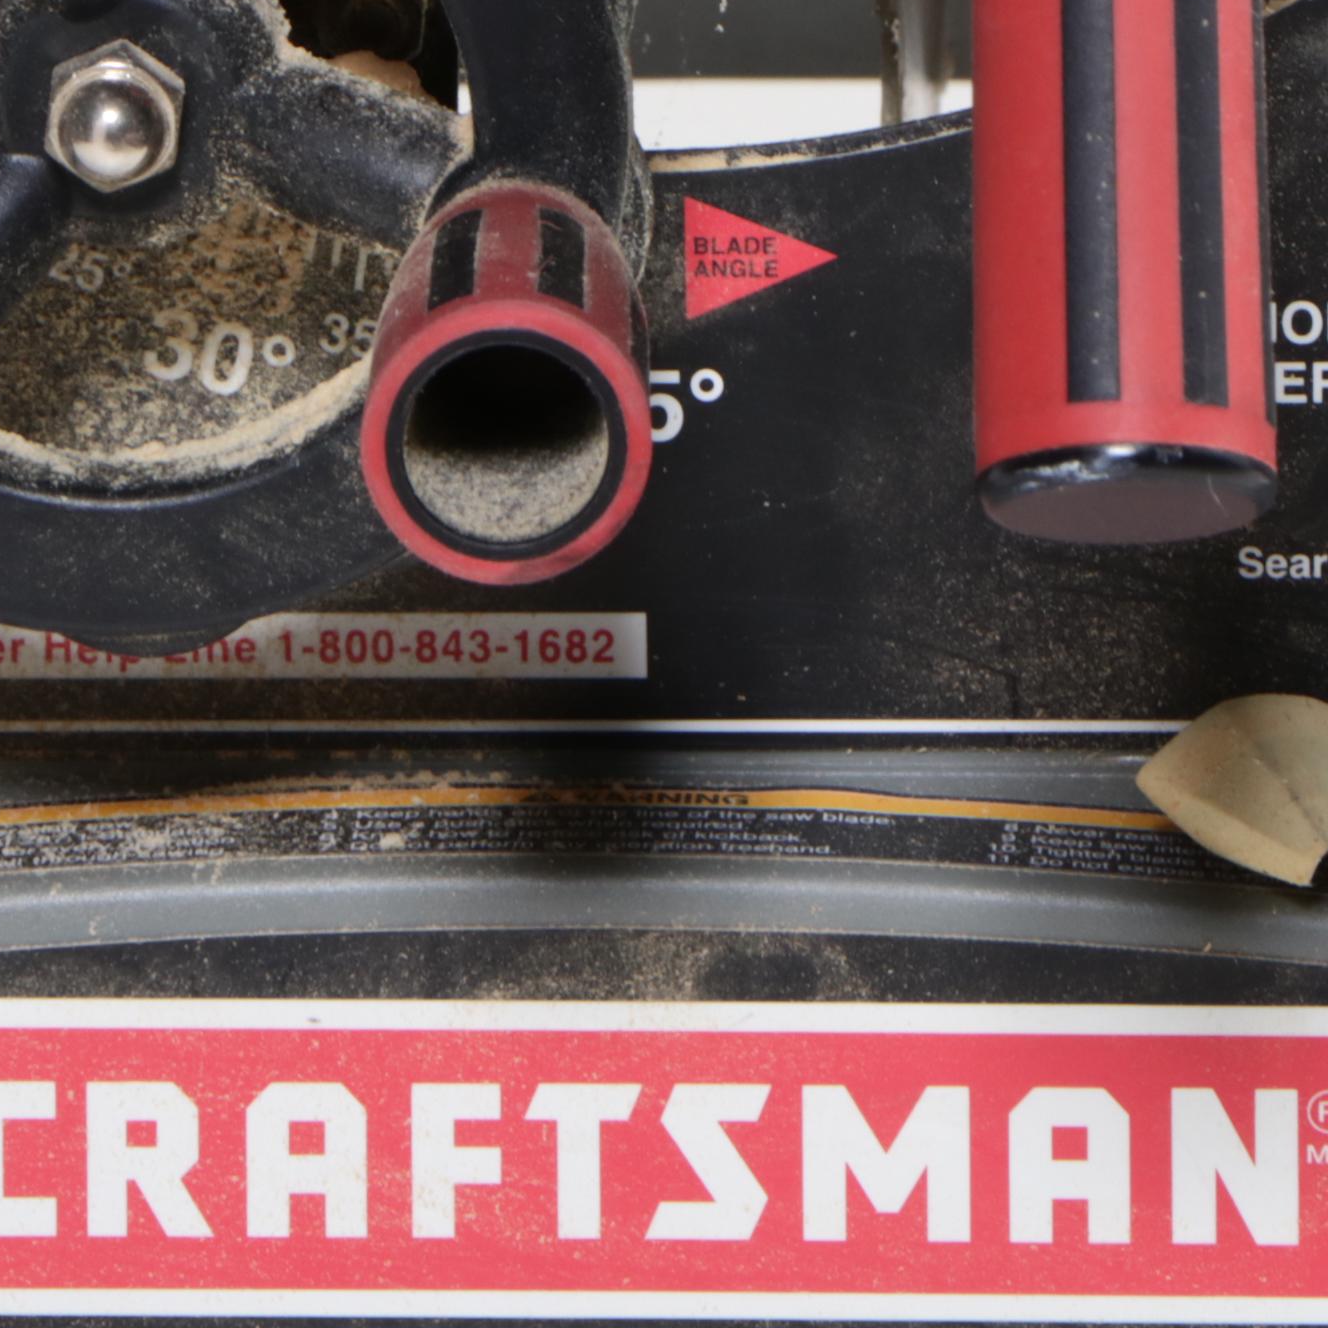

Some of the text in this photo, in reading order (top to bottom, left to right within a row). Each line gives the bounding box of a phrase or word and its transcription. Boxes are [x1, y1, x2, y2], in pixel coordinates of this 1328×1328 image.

[694, 237, 777, 255] BLADE
[693, 260, 778, 278] ANGLE
[649, 368, 725, 443] 5°
[277, 627, 616, 666] 1-800-843-1682
[356, 810, 420, 820] Keep
[688, 810, 710, 819] of
[718, 810, 758, 821] the
[765, 812, 815, 822] saw
[1035, 824, 1105, 838] Never
[1030, 835, 1093, 849] Keep
[1100, 840, 1147, 851] saw
[1032, 845, 1121, 860] Tighten
[1029, 856, 1064, 867] Do
[1071, 859, 1109, 871] not
